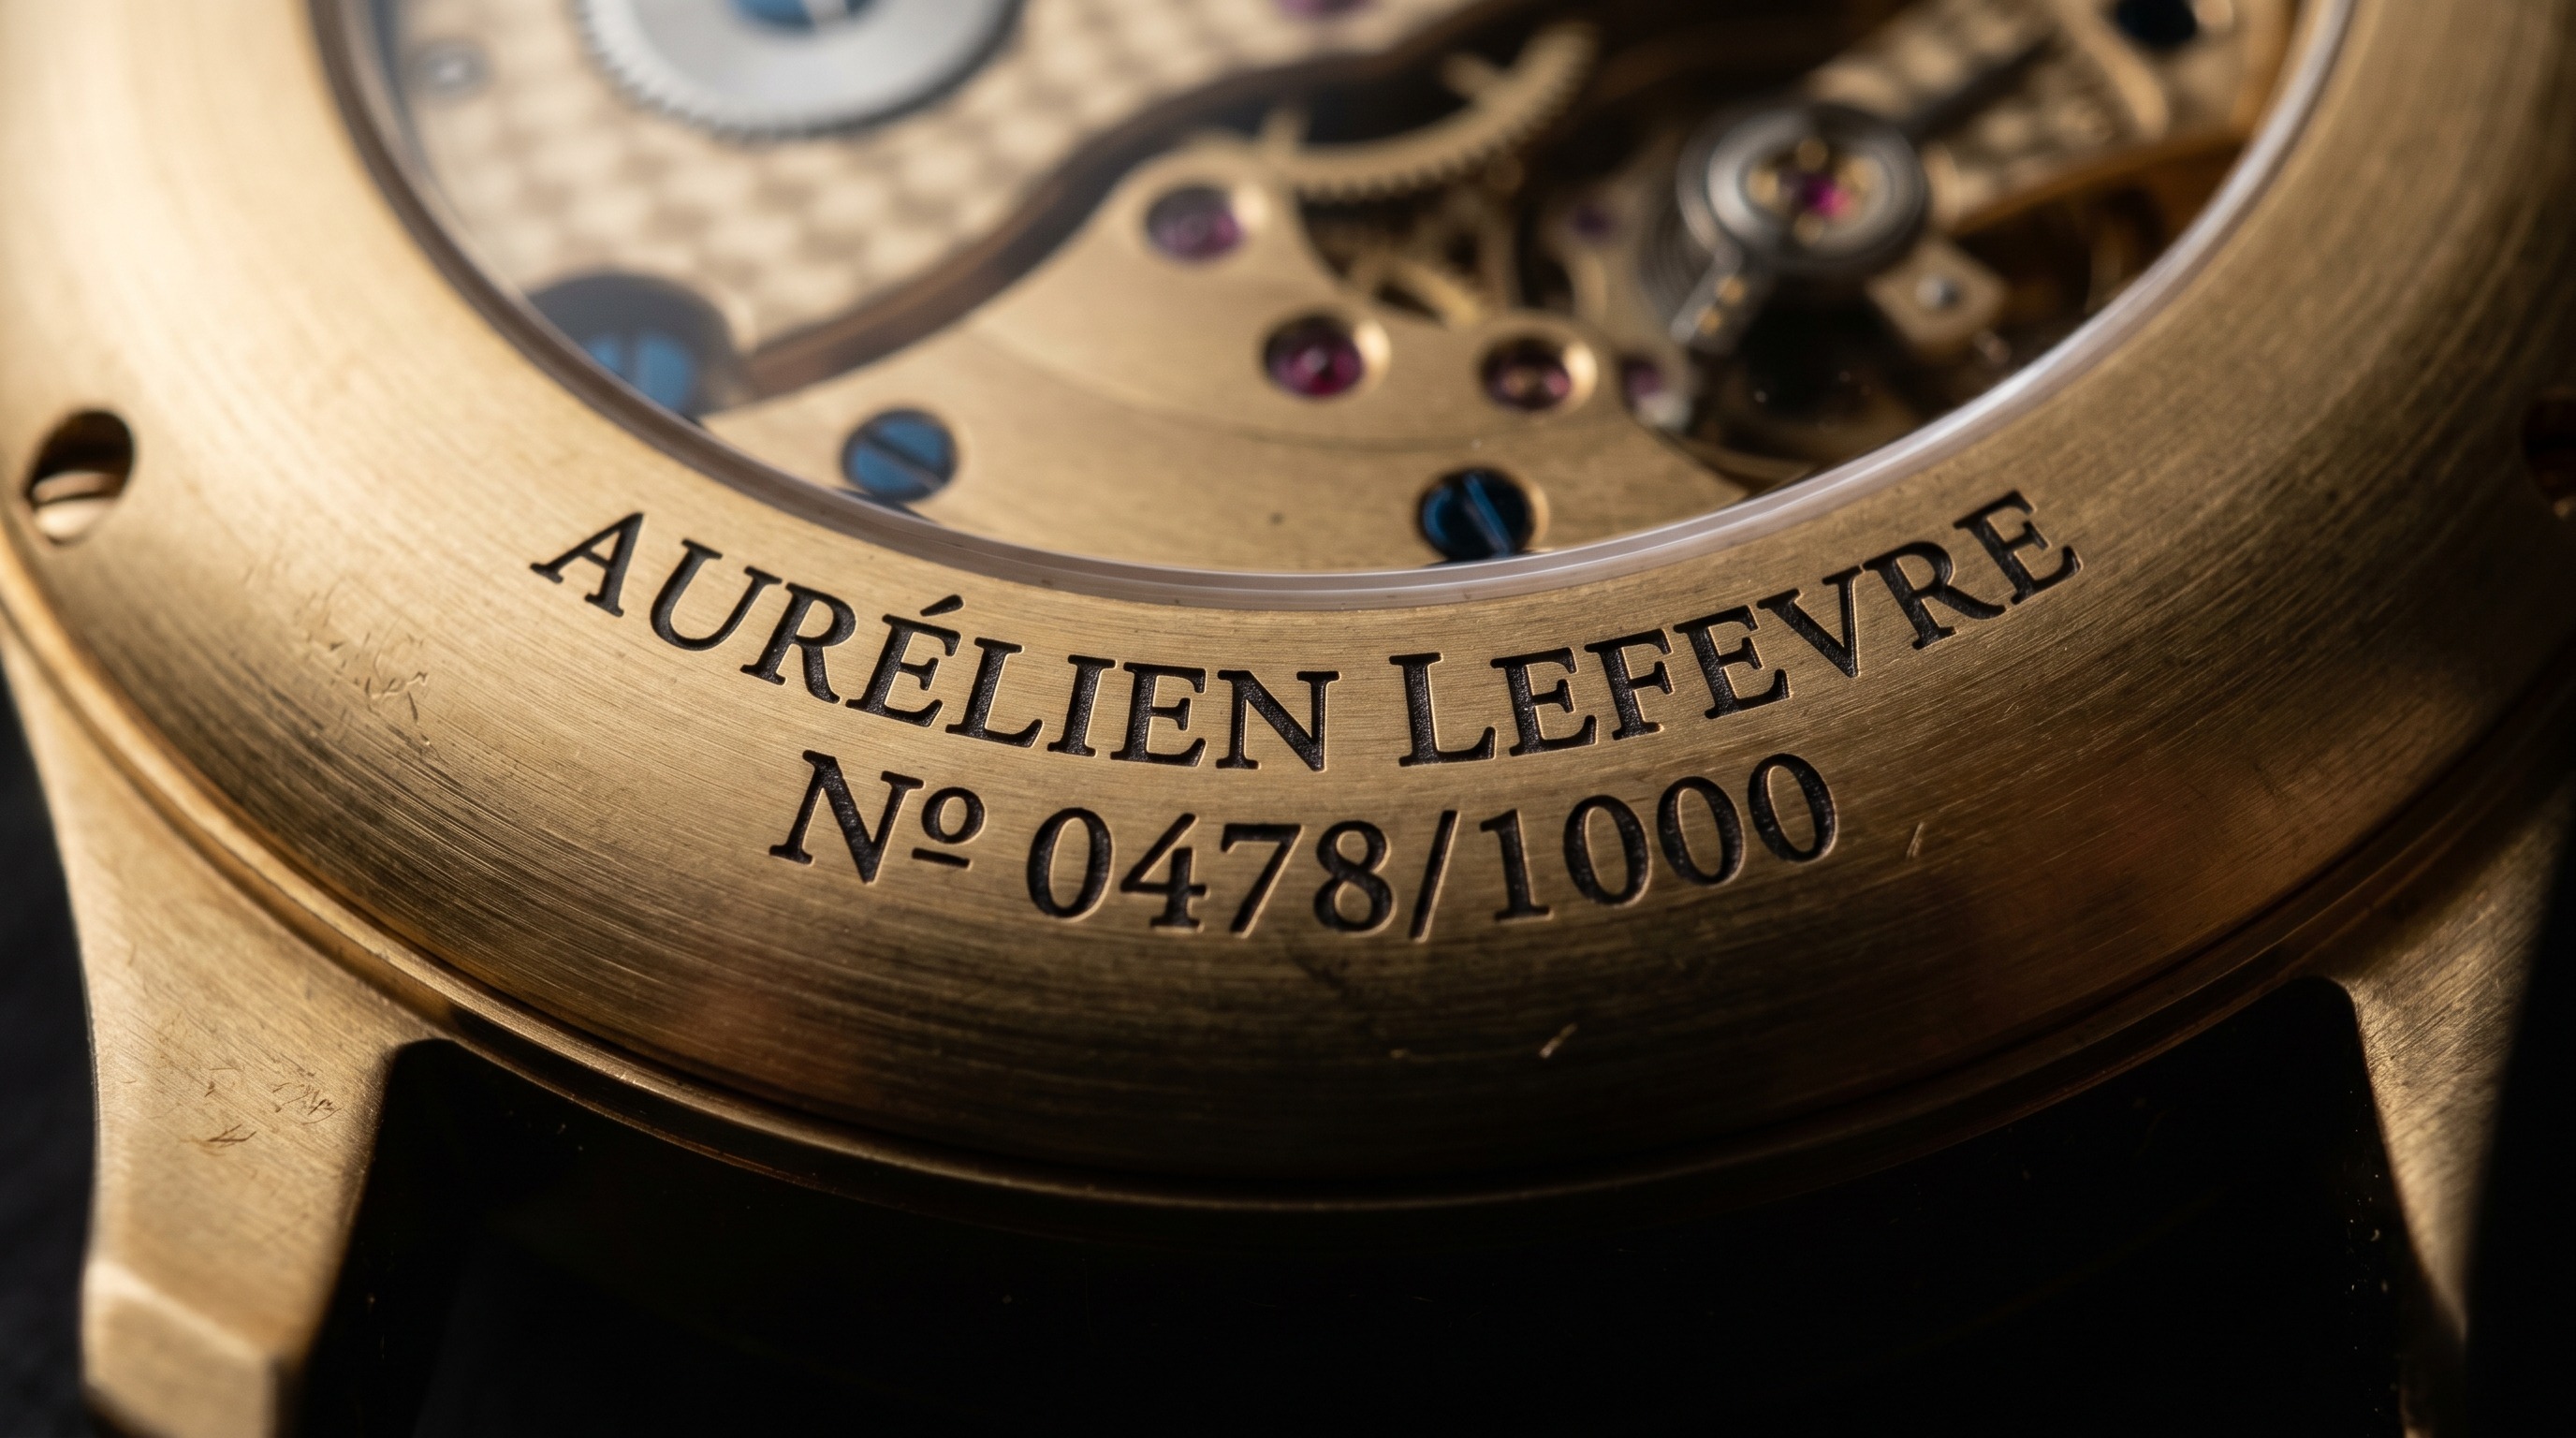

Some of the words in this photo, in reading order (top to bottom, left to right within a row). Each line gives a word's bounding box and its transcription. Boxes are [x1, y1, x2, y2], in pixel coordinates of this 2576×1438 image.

[530, 512, 1340, 771] AURÉLIEN
[1389, 491, 2083, 767] LEFEVRE
[1026, 754, 1839, 942] 0478/1000
